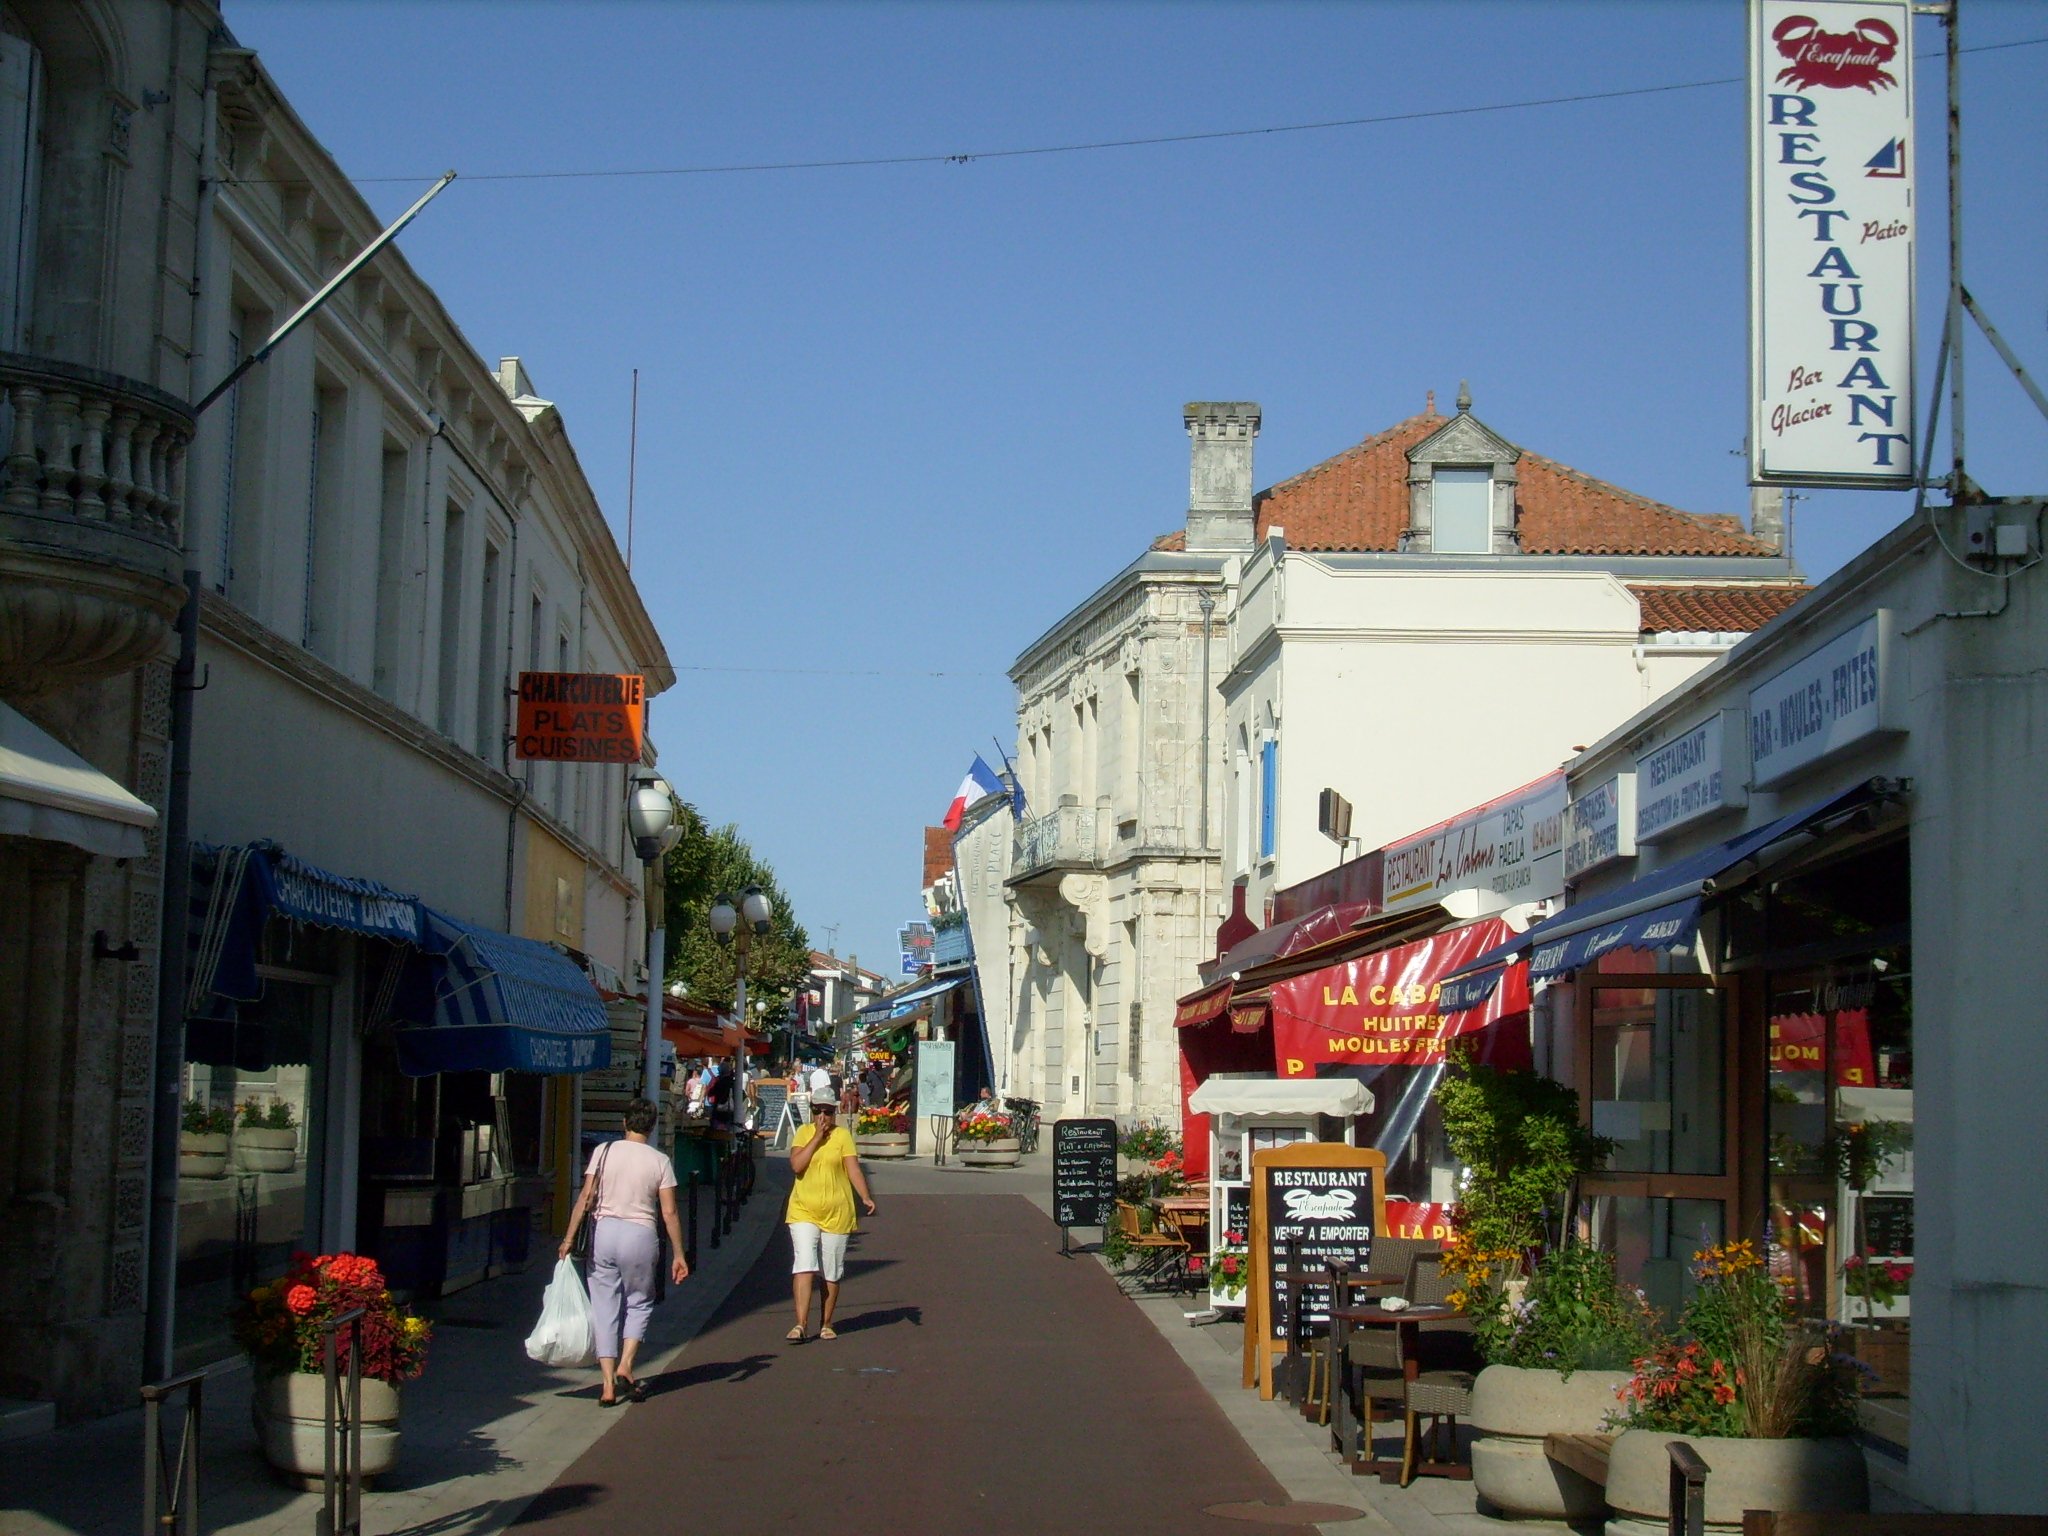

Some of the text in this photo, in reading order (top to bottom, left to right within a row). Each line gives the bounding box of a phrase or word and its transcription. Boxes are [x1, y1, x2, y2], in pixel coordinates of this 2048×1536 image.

[1860, 219, 1909, 244] Patio
[1767, 93, 1910, 467] RESTAURANT
[1787, 365, 1823, 393] Bar
[1771, 398, 1833, 437] Glacier
[521, 673, 641, 706] CHARCUTERIE
[1752, 645, 1877, 763] BAR MOULES FRITES
[534, 709, 624, 734] PLATS
[521, 735, 635, 760] CUISINES
[1650, 730, 1706, 789] RESTAURANT
[1503, 805, 1525, 837] TAPAS
[1499, 836, 1525, 868] PAELLA
[1387, 839, 1436, 892] RESTAURANT
[1323, 985, 1359, 1007] LA
[1363, 1014, 1447, 1032] HUITRES
[869, 1052, 890, 1060] CAVE
[1328, 1037, 1411, 1053] MOULES
[1273, 1171, 1368, 1187] RESTAURANT
[1298, 1199, 1344, 1217] l'Escapade
[1308, 1226, 1316, 1240] A
[1320, 1226, 1370, 1241] EMPORTER
[1400, 1224, 1425, 1240] LA
